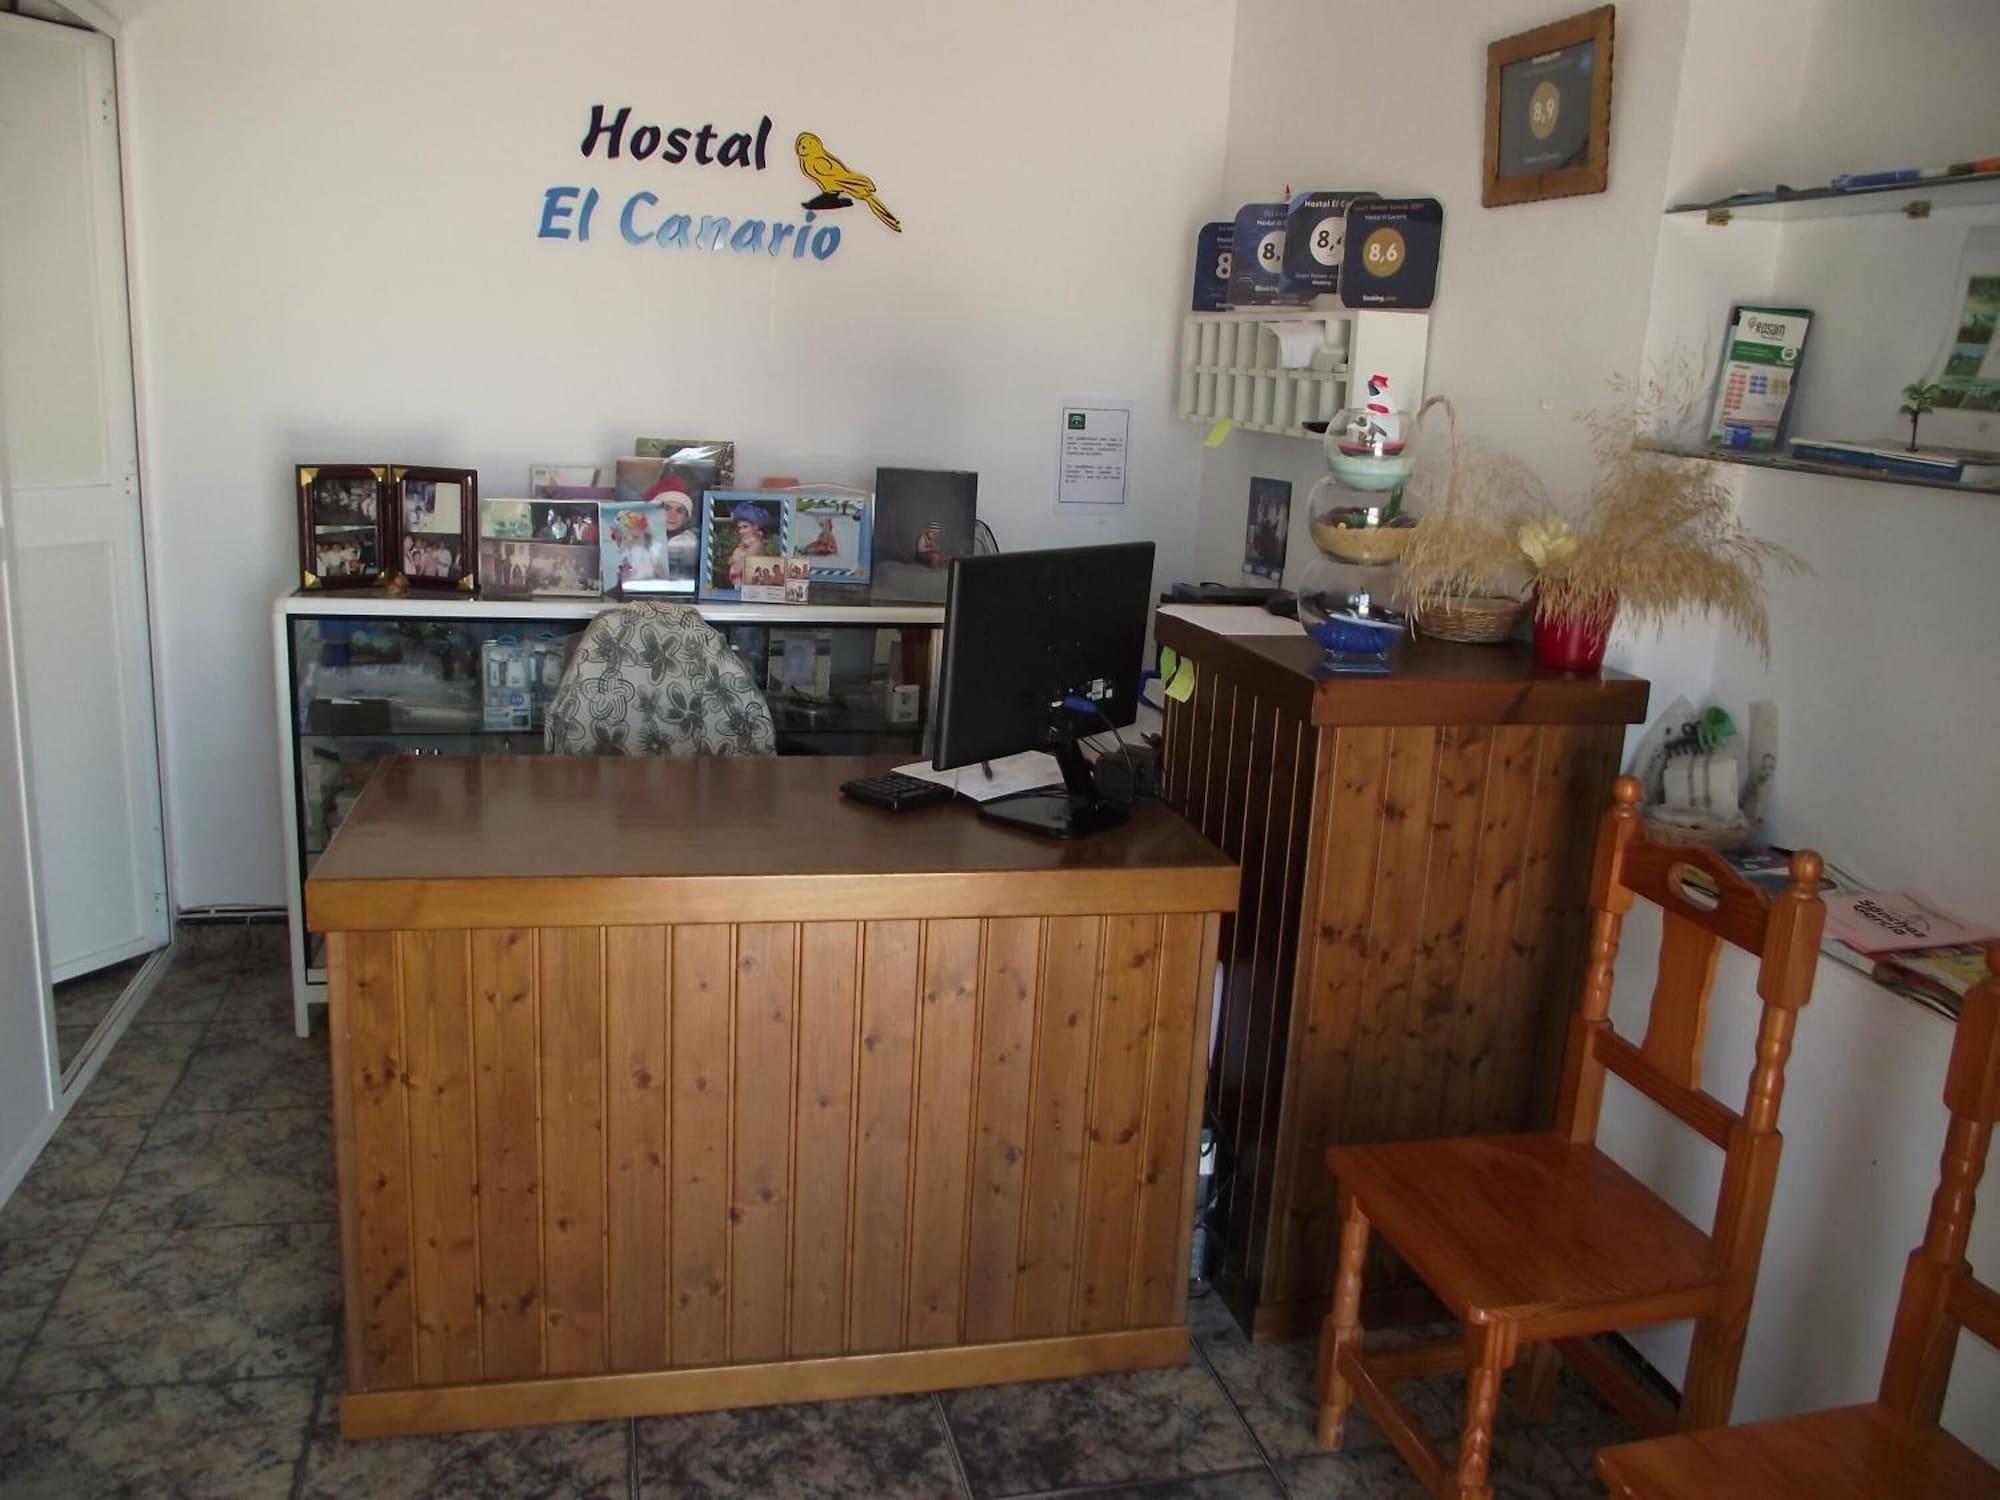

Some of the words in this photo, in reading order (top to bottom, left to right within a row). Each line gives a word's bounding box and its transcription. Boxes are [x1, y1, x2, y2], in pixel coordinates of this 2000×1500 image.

[581, 104, 773, 171] Hostal
[537, 186, 600, 242] El
[619, 191, 842, 261] Canario
[1368, 242, 1399, 264] 8,6
